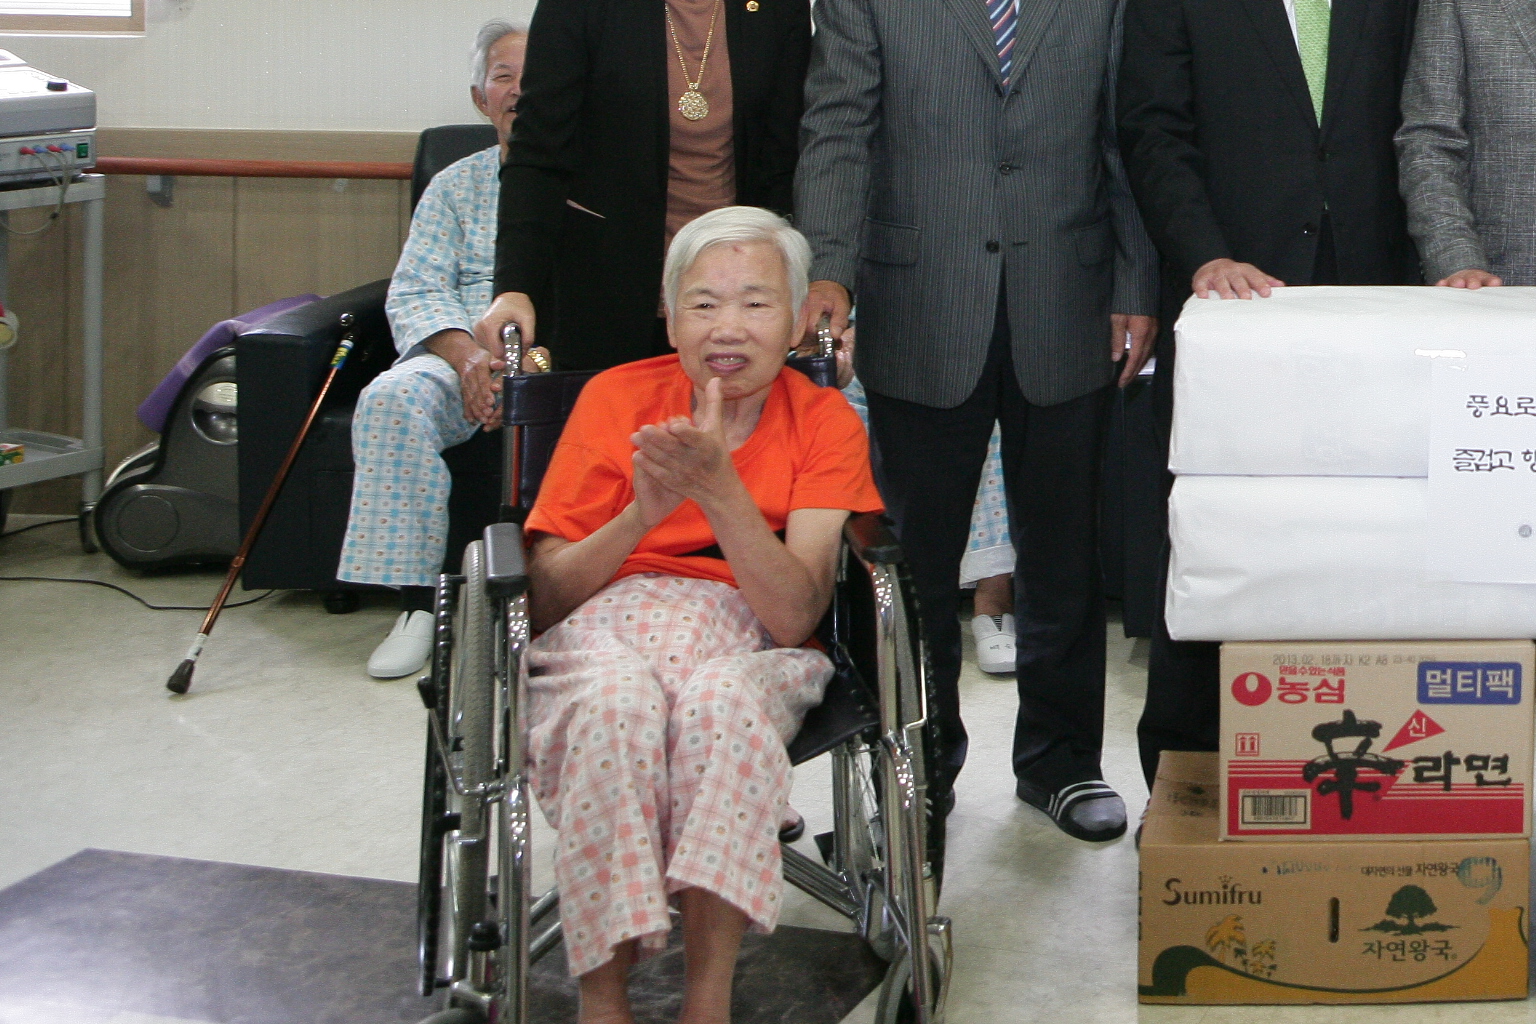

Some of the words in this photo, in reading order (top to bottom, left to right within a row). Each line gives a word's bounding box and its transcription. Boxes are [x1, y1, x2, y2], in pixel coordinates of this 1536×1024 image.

[1453, 448, 1515, 473] 즐겁고
[1276, 676, 1346, 705] 농심
[1425, 668, 1514, 698] 멀티팩
[1408, 717, 1427, 738] 신
[1302, 709, 1405, 820] 辛
[1412, 750, 1513, 792] 라면
[1416, 862, 1460, 877] 자연왕국
[1162, 877, 1262, 907] Sumifru
[1361, 939, 1453, 963] 자연왕국
